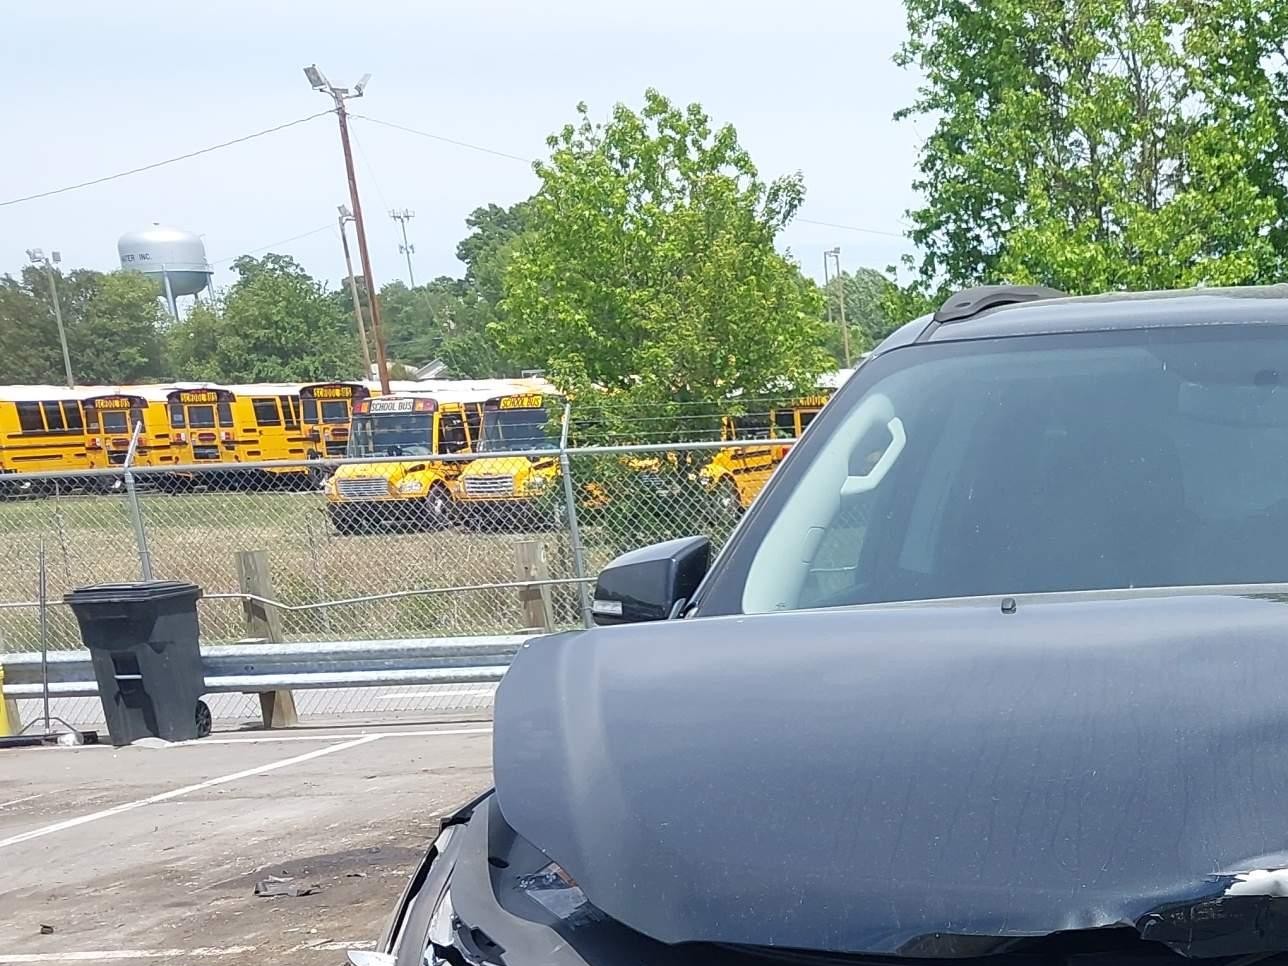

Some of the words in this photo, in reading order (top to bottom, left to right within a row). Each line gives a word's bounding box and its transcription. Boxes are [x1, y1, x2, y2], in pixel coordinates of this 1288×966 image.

[372, 401, 396, 412] SCHOOL
[398, 400, 412, 411] BUS
[502, 398, 524, 408] SCHOOL
[527, 396, 540, 407] BUS
